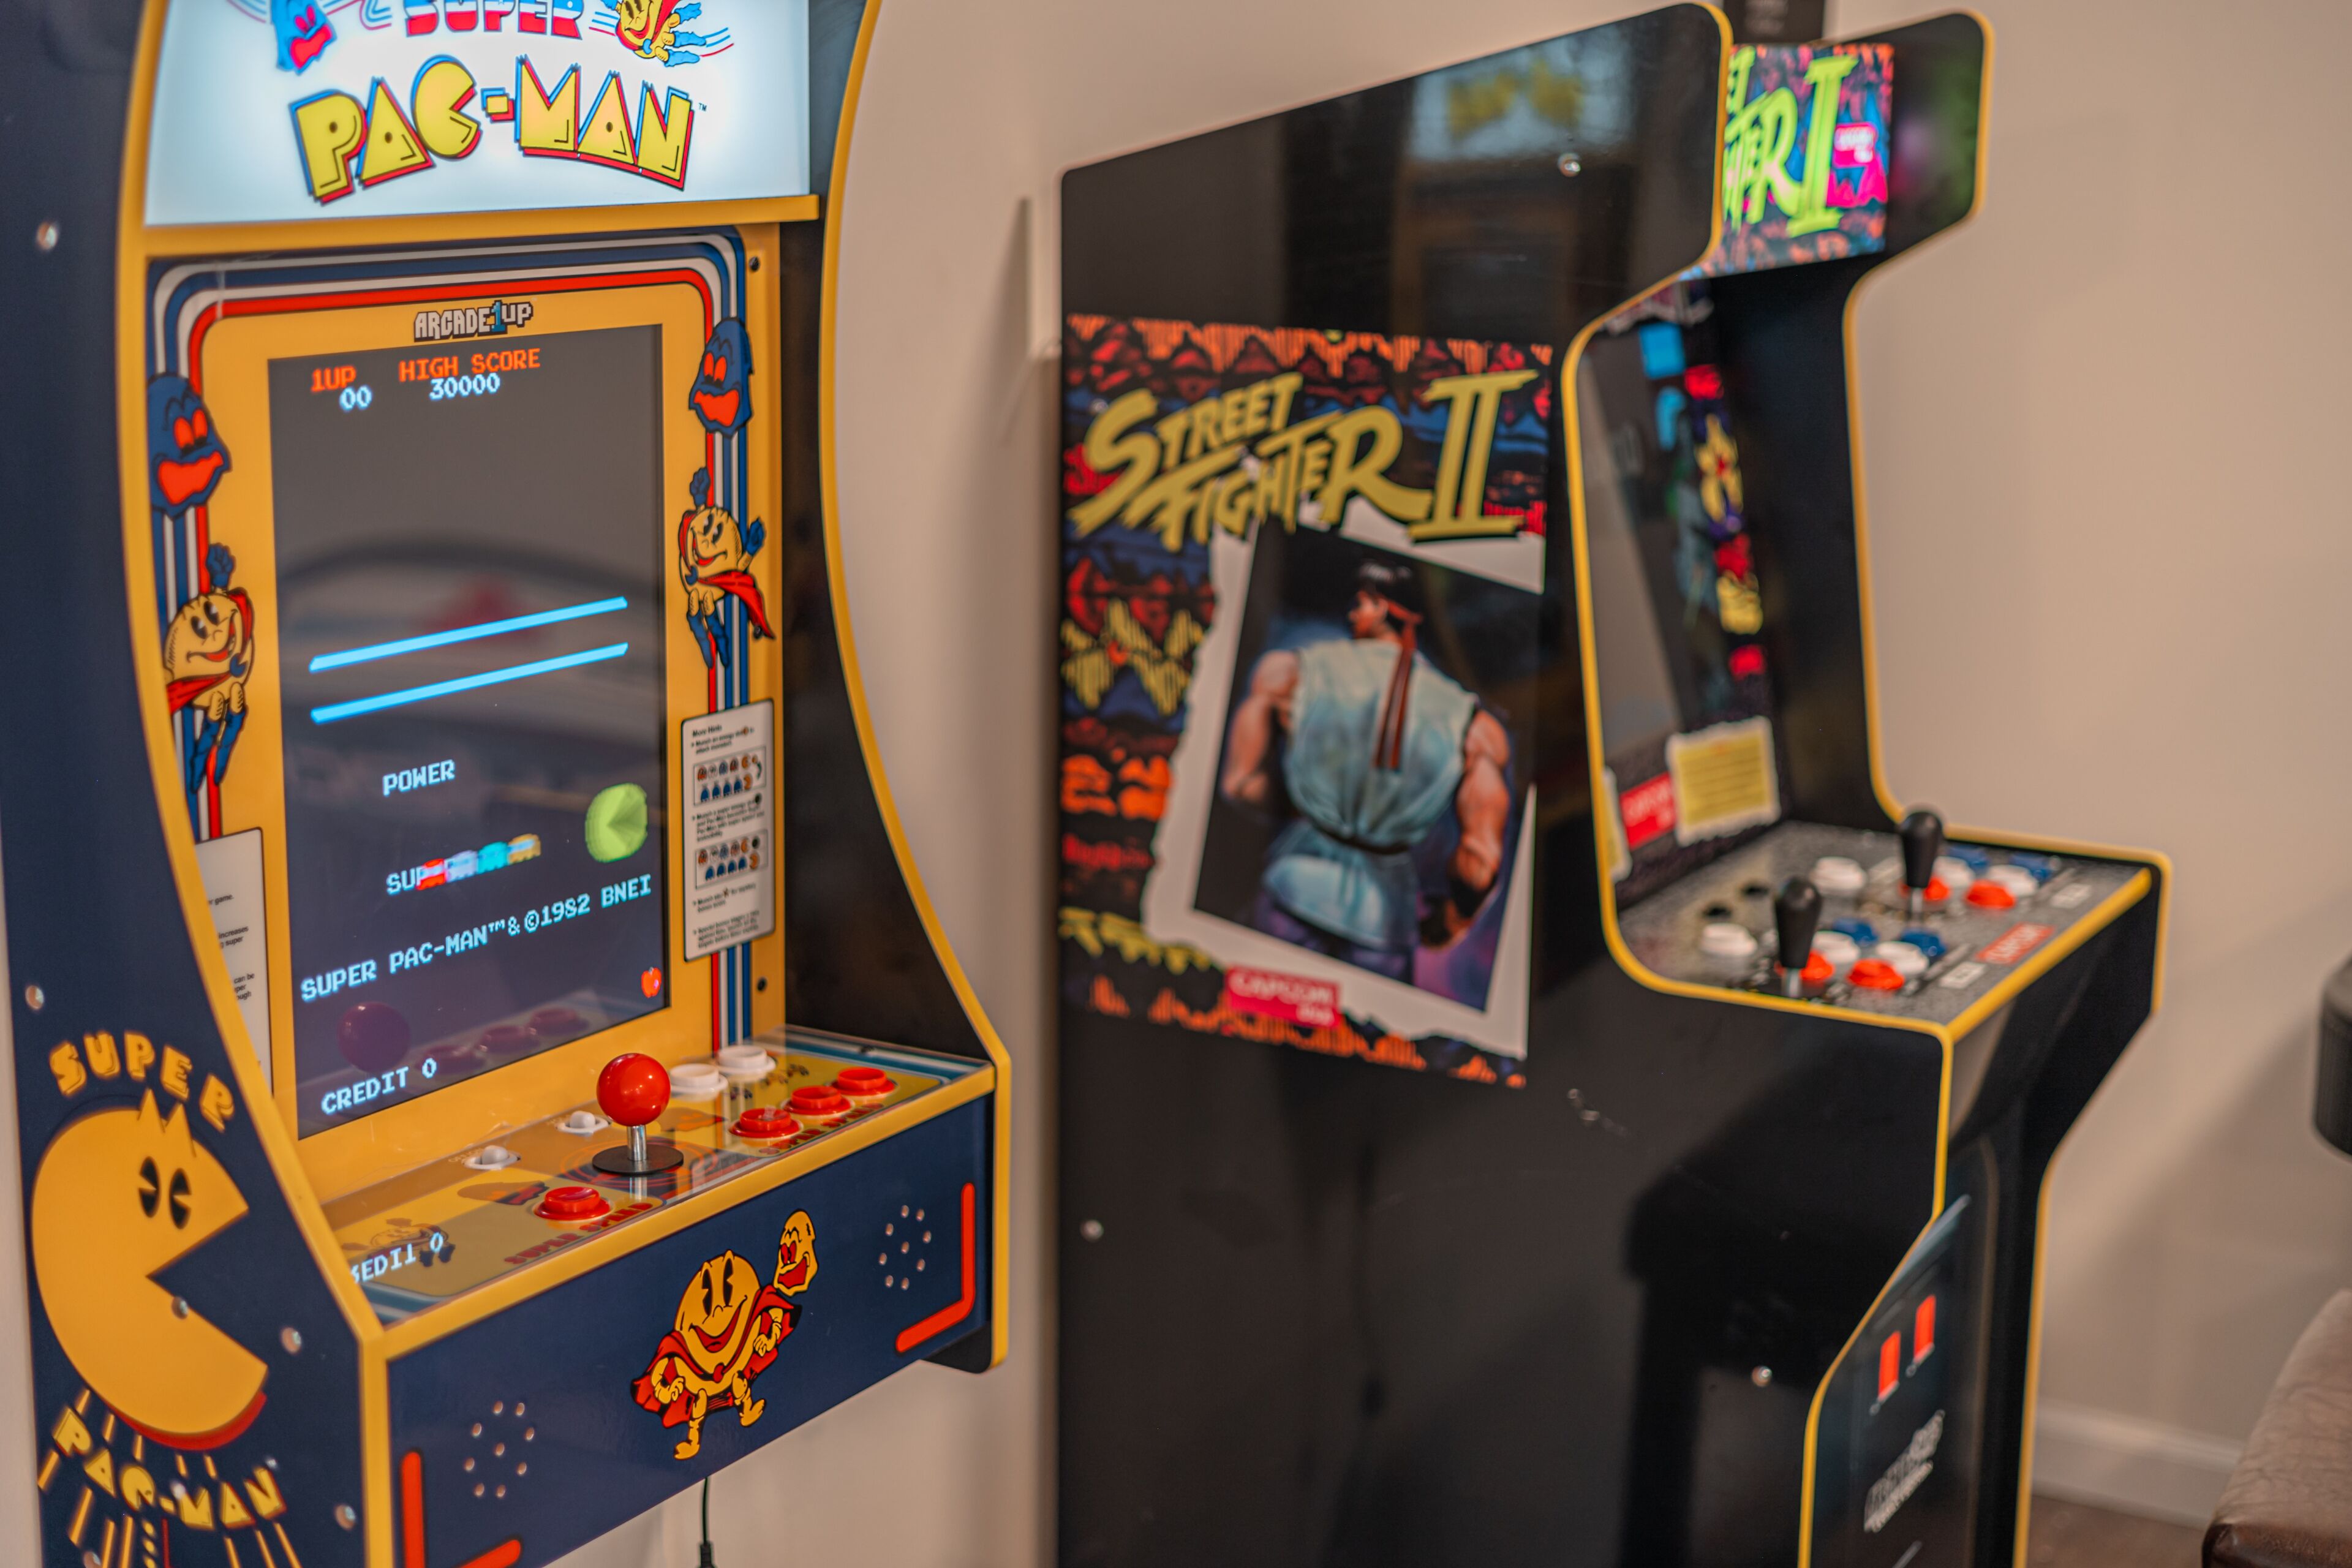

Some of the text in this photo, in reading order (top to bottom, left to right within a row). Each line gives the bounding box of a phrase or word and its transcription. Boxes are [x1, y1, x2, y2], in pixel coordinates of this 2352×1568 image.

[403, 0, 584, 40] SUPER
[289, 54, 694, 205] PAC-MAN
[311, 348, 541, 393] 1UP HIGH SCORE
[339, 372, 500, 413] 00 30000
[1068, 372, 1303, 538] STREET
[1121, 405, 1433, 552] FIGHTER
[1407, 369, 1539, 543] II
[382, 759, 456, 796] POWER
[218, 926, 249, 940] increases
[225, 936, 244, 946] super
[301, 959, 377, 1002] SUPER
[600, 873, 652, 908] BNEI
[48, 1030, 235, 1133] SUPER
[320, 1057, 437, 1116] CREDIT 0
[52, 1406, 286, 1529] PAC-MAN
